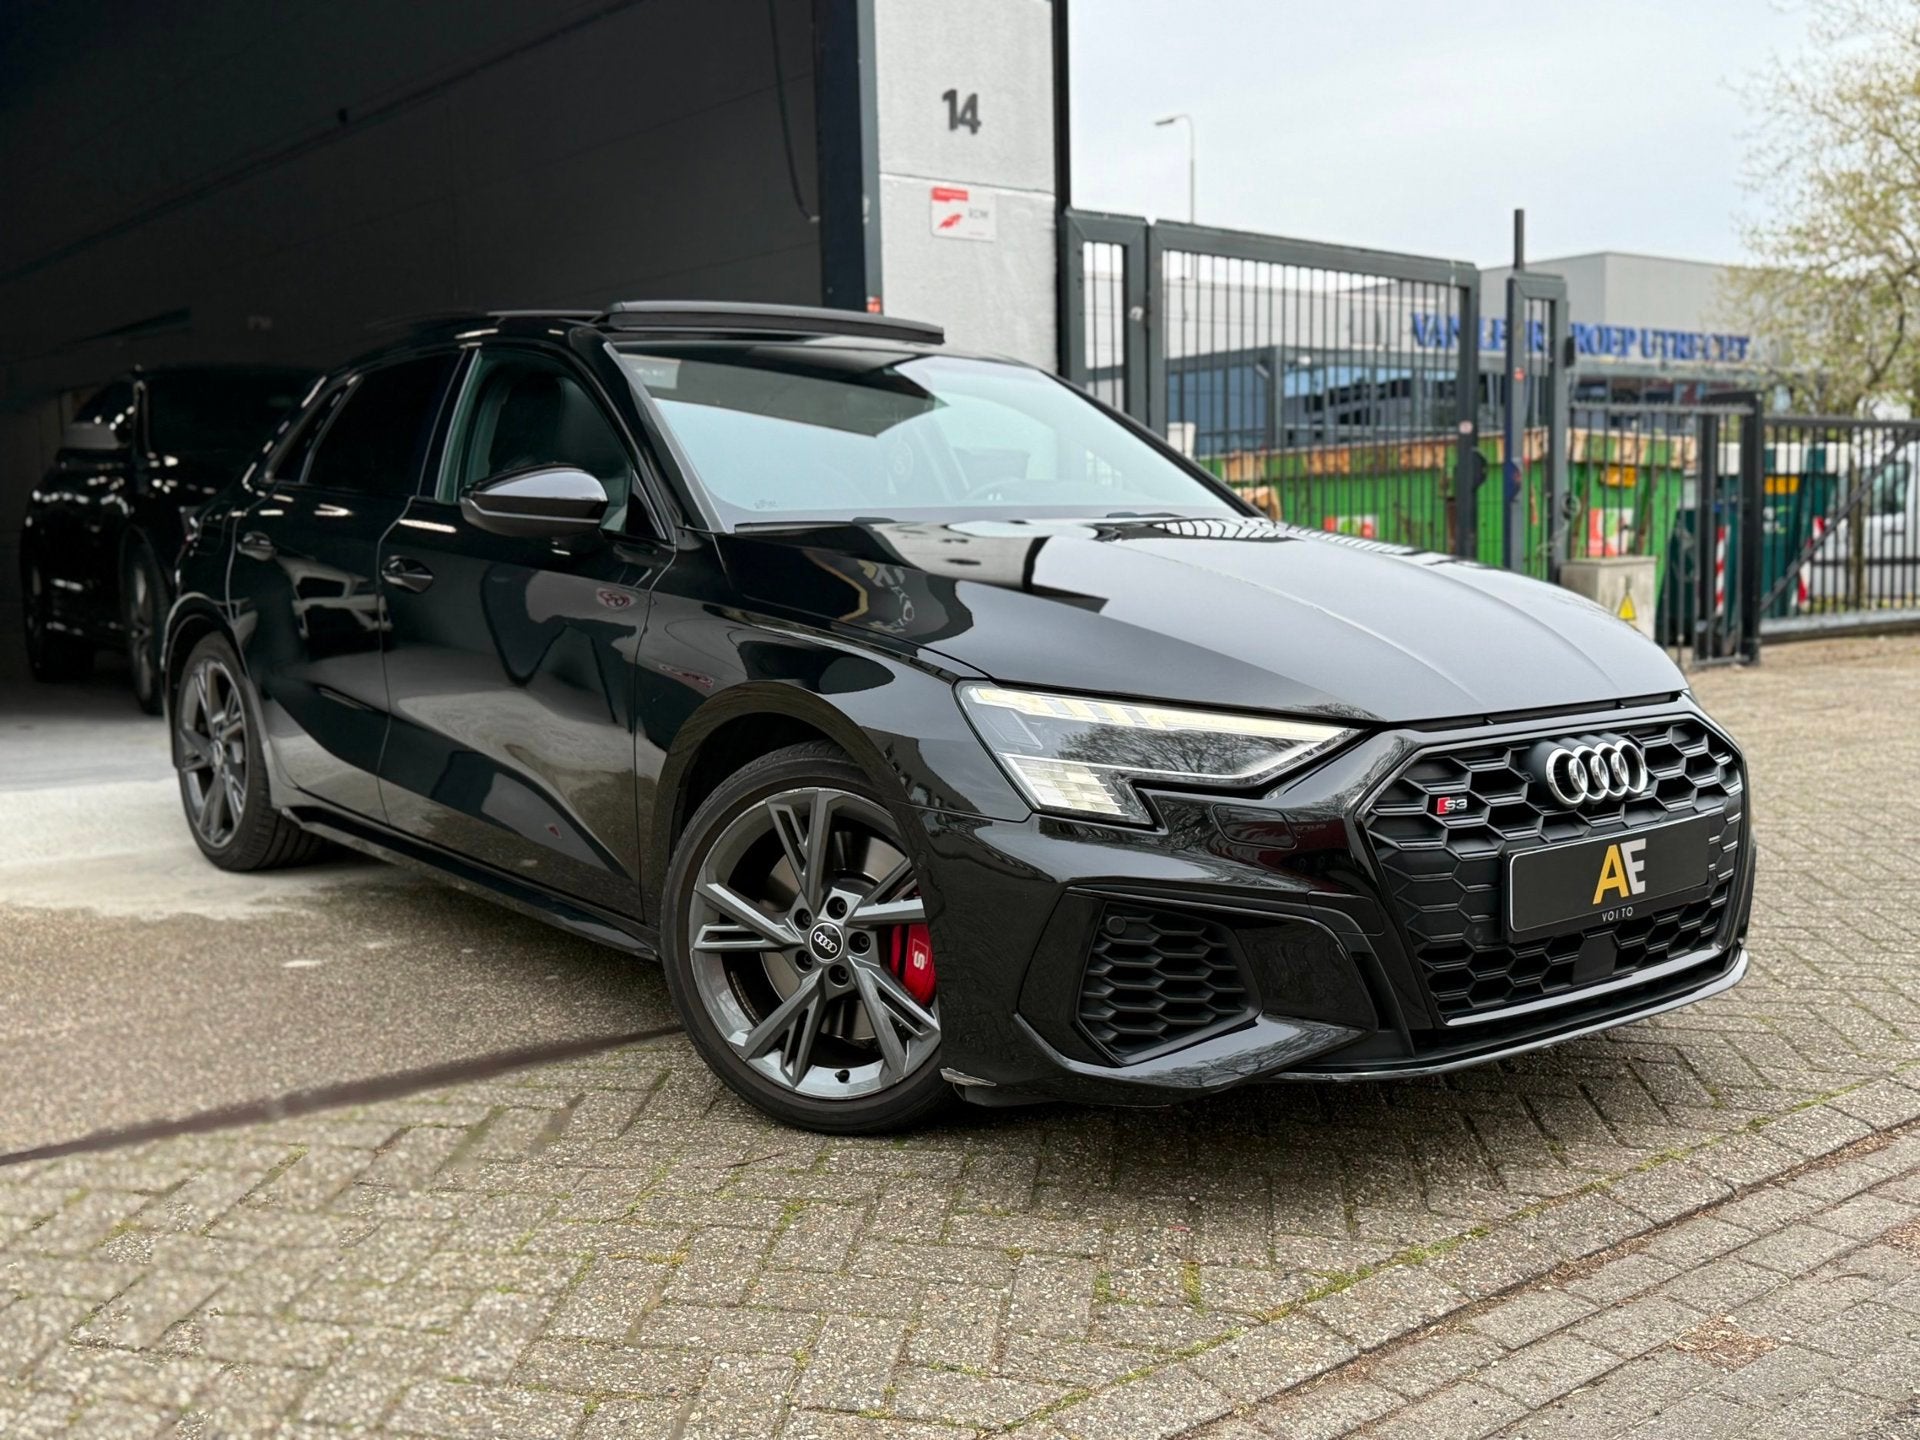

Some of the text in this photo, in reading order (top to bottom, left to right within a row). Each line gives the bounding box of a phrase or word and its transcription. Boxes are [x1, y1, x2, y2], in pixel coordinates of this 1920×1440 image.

[942, 88, 982, 135] 14
[1411, 312, 1750, 361] VAN LER ROEP UTRECHT
[1444, 798, 1468, 811] S3
[1593, 838, 1647, 905] AE
[913, 950, 926, 970] S
